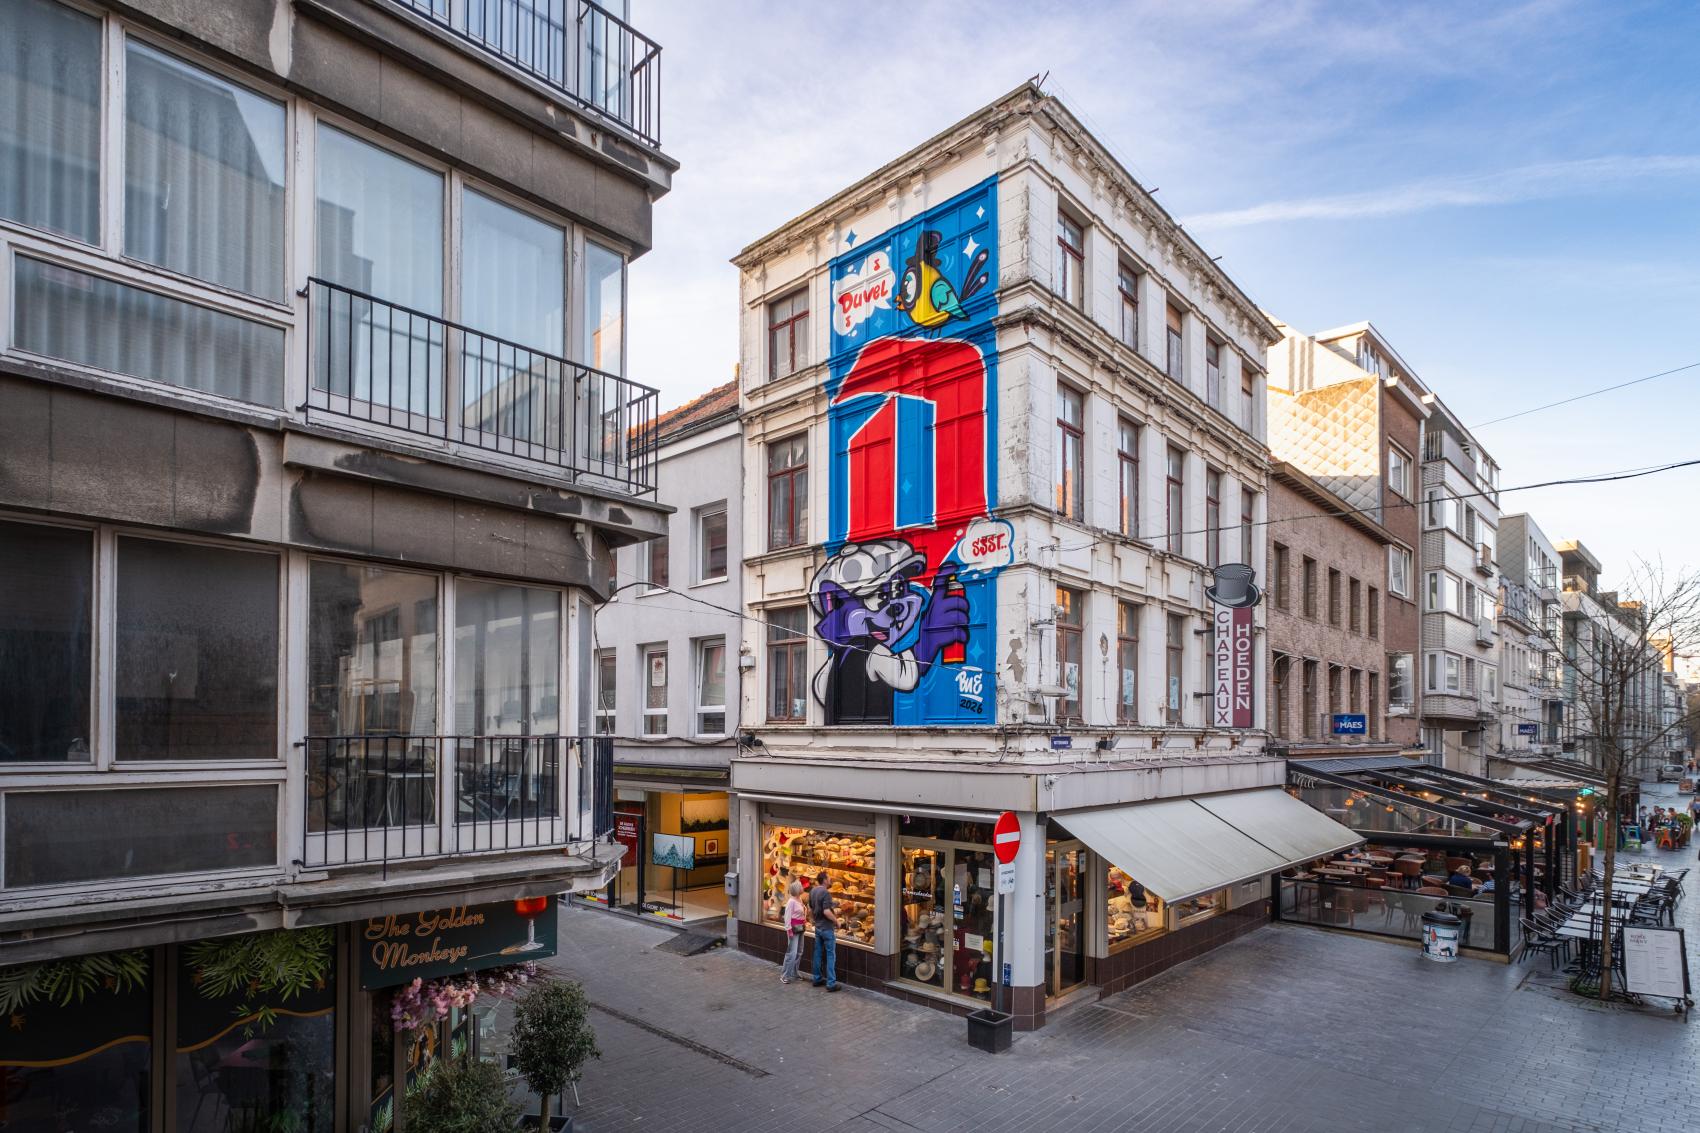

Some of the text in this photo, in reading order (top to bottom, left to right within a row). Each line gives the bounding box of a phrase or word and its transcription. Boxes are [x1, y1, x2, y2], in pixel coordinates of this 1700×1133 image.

[838, 279, 889, 314] Duvel
[1216, 611, 1230, 724] CHAPEAUX
[1235, 624, 1250, 710] HOEDEN
[1339, 721, 1363, 729] MAES
[365, 904, 485, 939] The Golden
[372, 937, 468, 970] Monkeys
